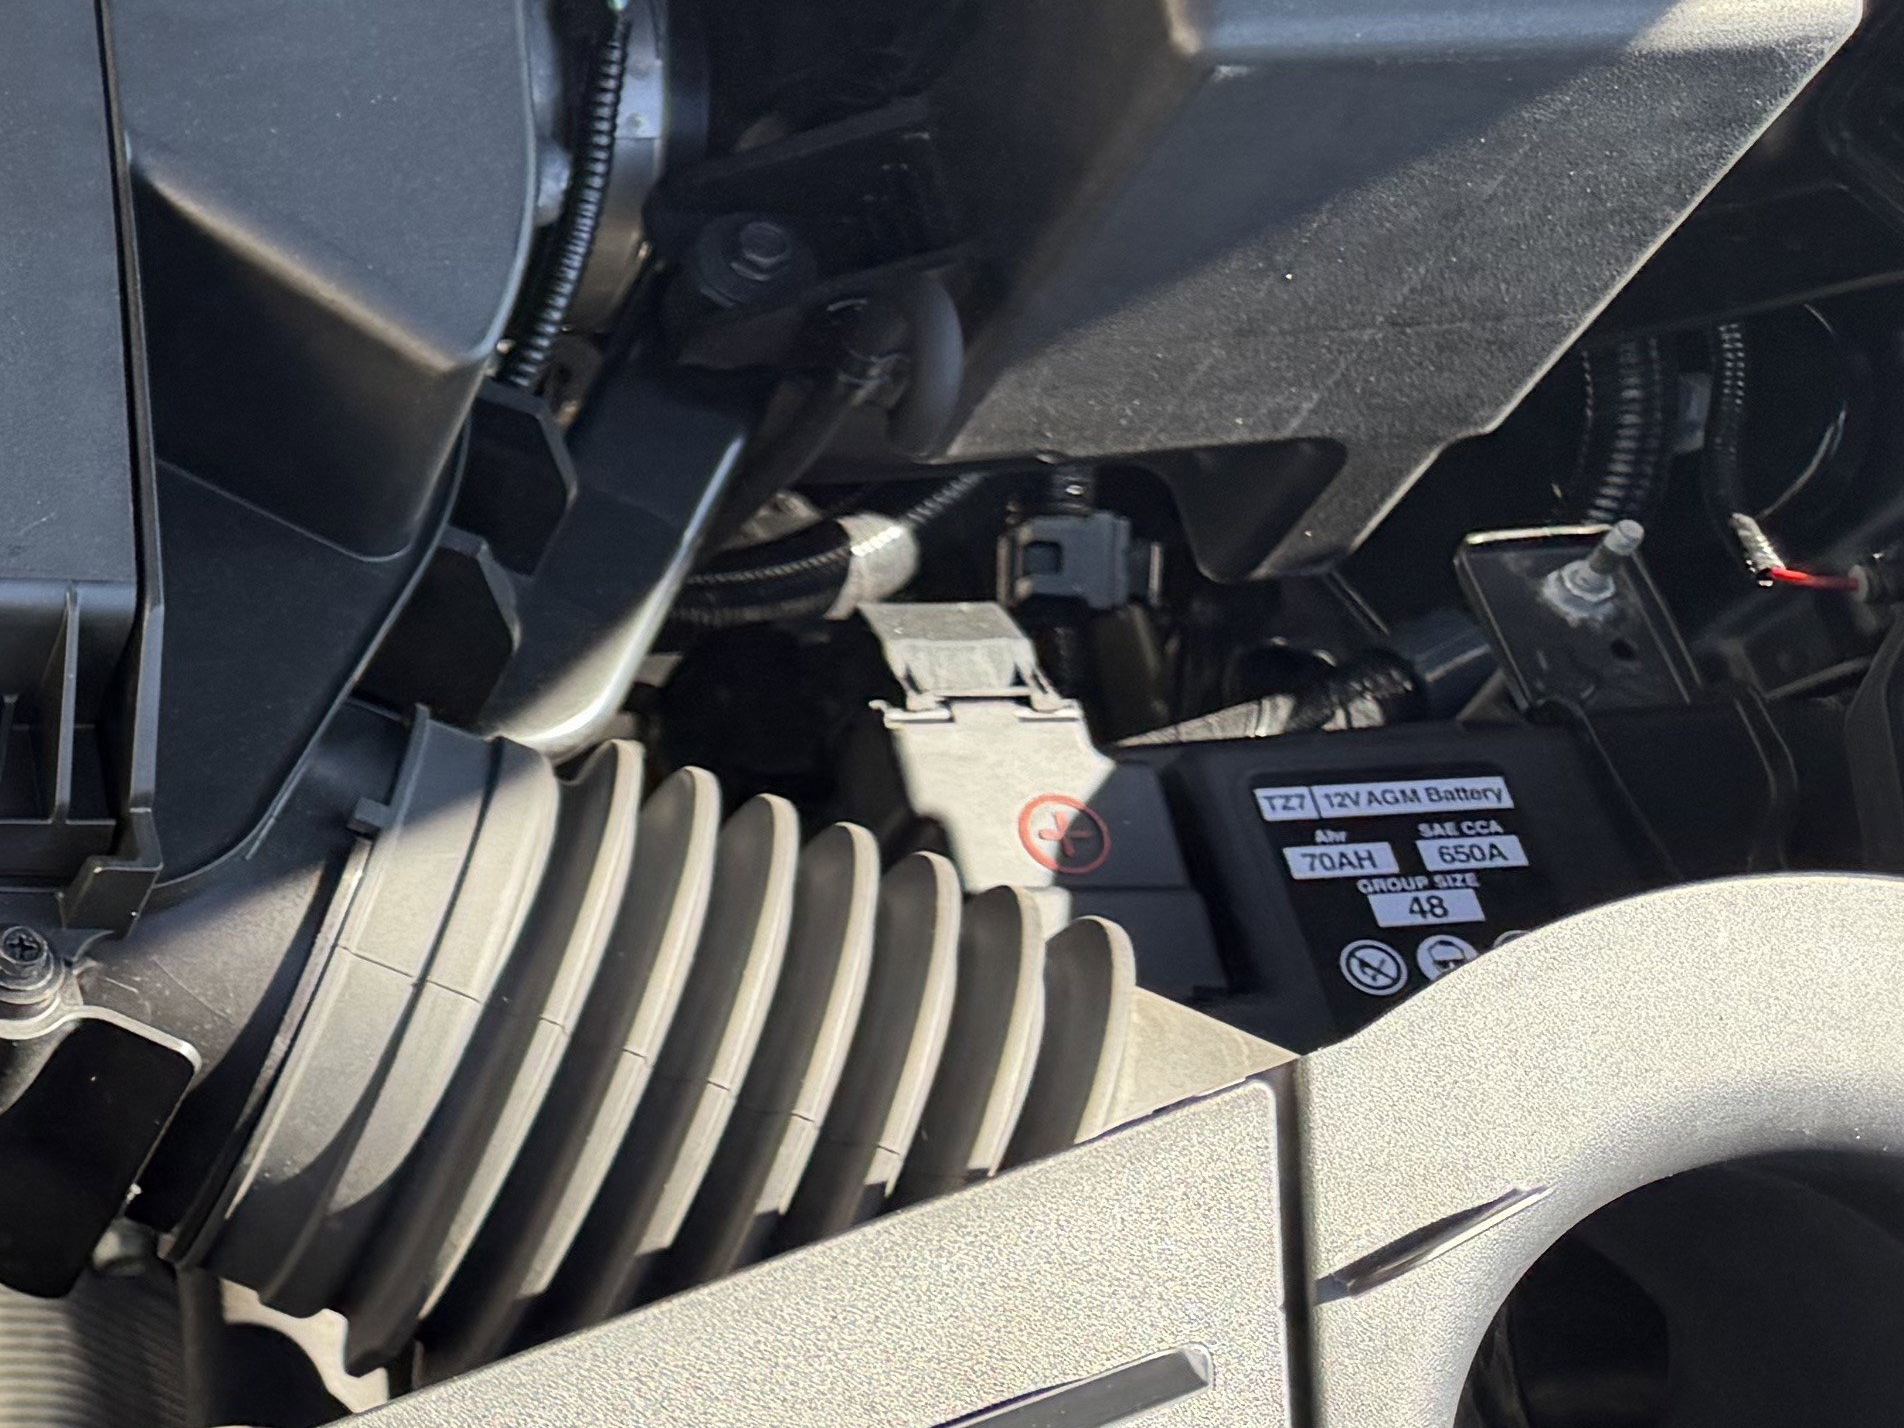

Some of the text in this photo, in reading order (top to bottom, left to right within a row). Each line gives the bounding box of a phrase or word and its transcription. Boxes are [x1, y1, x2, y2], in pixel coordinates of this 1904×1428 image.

[1262, 793, 1306, 811] TZ7
[1322, 785, 1503, 809] 12V AGM Battery
[1460, 820, 1504, 835] CCA
[1300, 849, 1378, 872] 70AH
[1439, 843, 1509, 865] 650A
[1357, 875, 1429, 894] GROUP
[1409, 895, 1449, 919] 48
